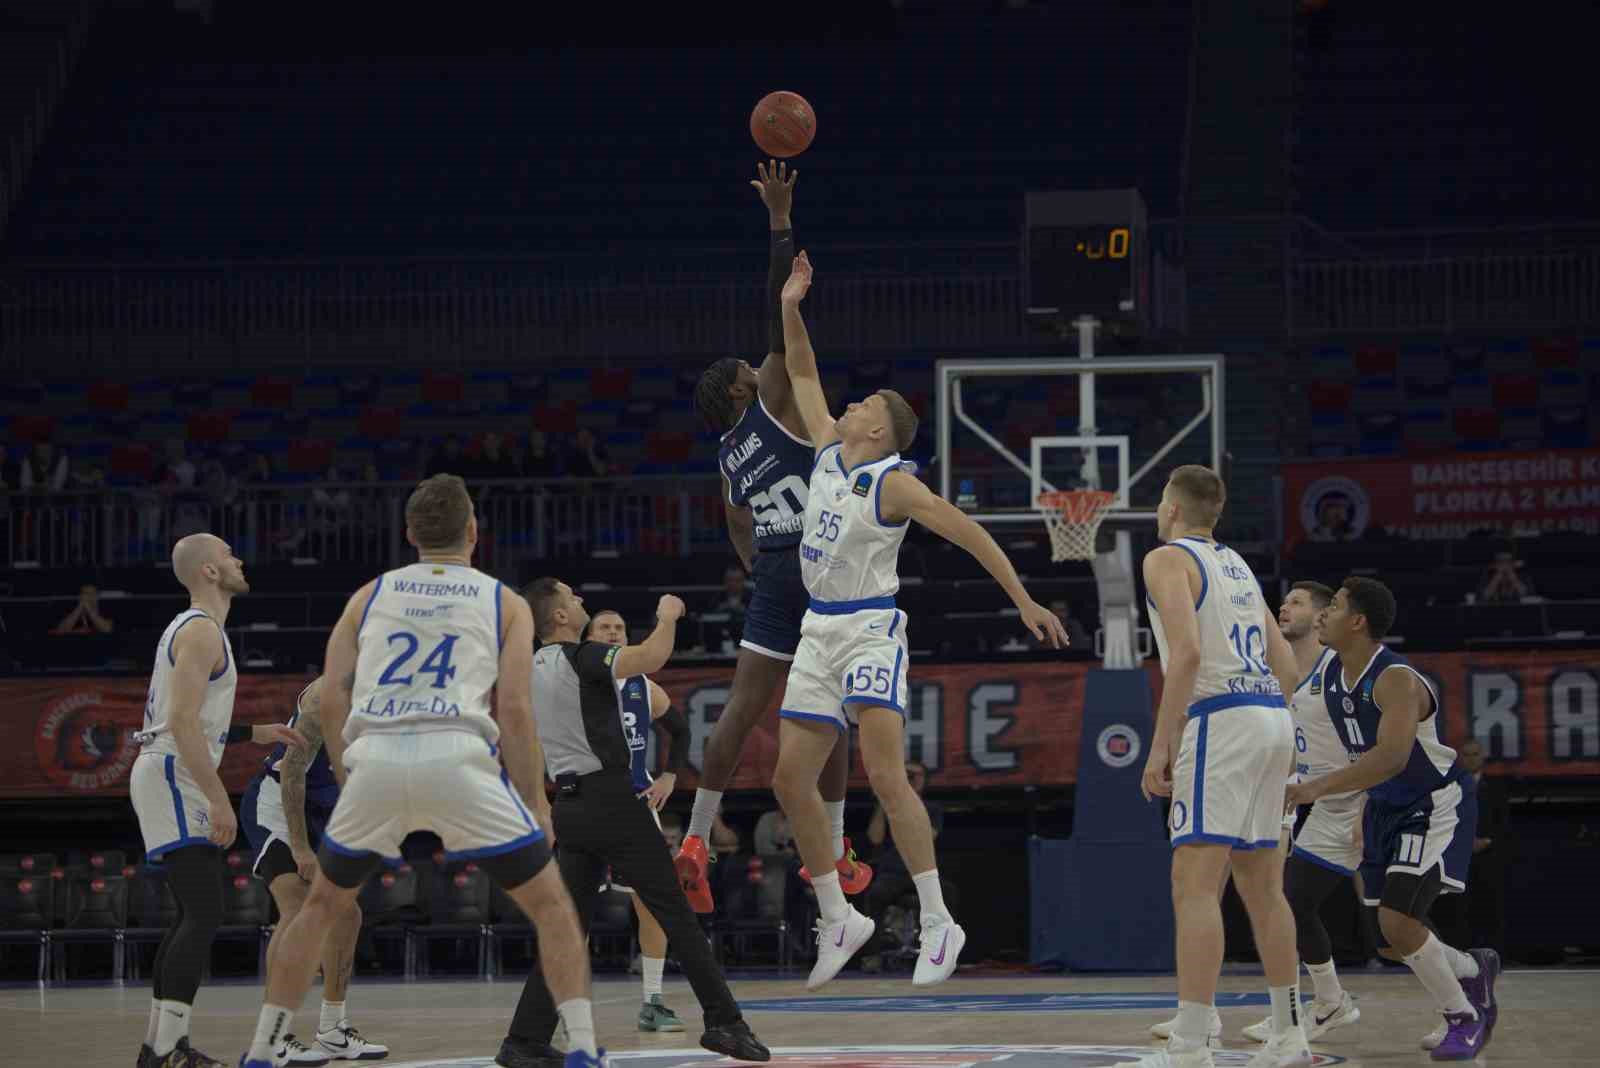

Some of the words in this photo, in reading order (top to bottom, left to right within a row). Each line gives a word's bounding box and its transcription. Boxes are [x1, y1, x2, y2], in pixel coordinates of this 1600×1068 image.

[726, 432, 763, 473] WILLIAMS
[749, 475, 809, 524] 50
[1413, 488, 1515, 513] FLORYA
[1519, 486, 1537, 513] 2
[815, 509, 842, 543] 55
[393, 580, 480, 598] WATERMAN
[377, 631, 462, 690] 24
[1229, 623, 1271, 676] 10
[854, 665, 891, 695] 55
[1343, 717, 1366, 746] 11
[1399, 833, 1425, 864] 11
